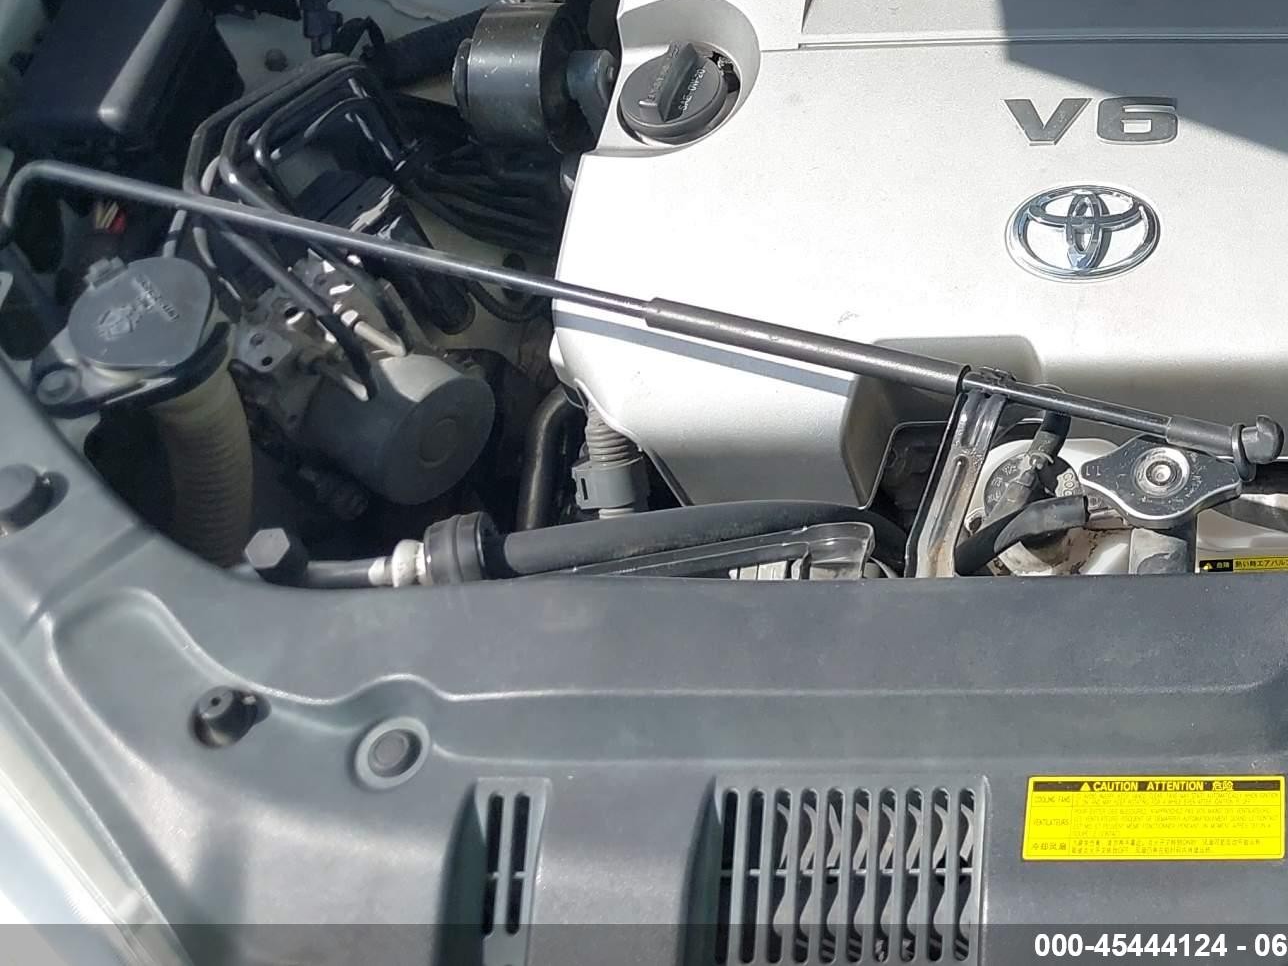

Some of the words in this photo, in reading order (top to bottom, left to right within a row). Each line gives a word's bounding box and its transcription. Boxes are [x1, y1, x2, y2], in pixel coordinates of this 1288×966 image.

[1000, 96, 1179, 146] V6
[1093, 781, 1138, 791] CAUTION
[1146, 781, 1203, 791] ATTENTION
